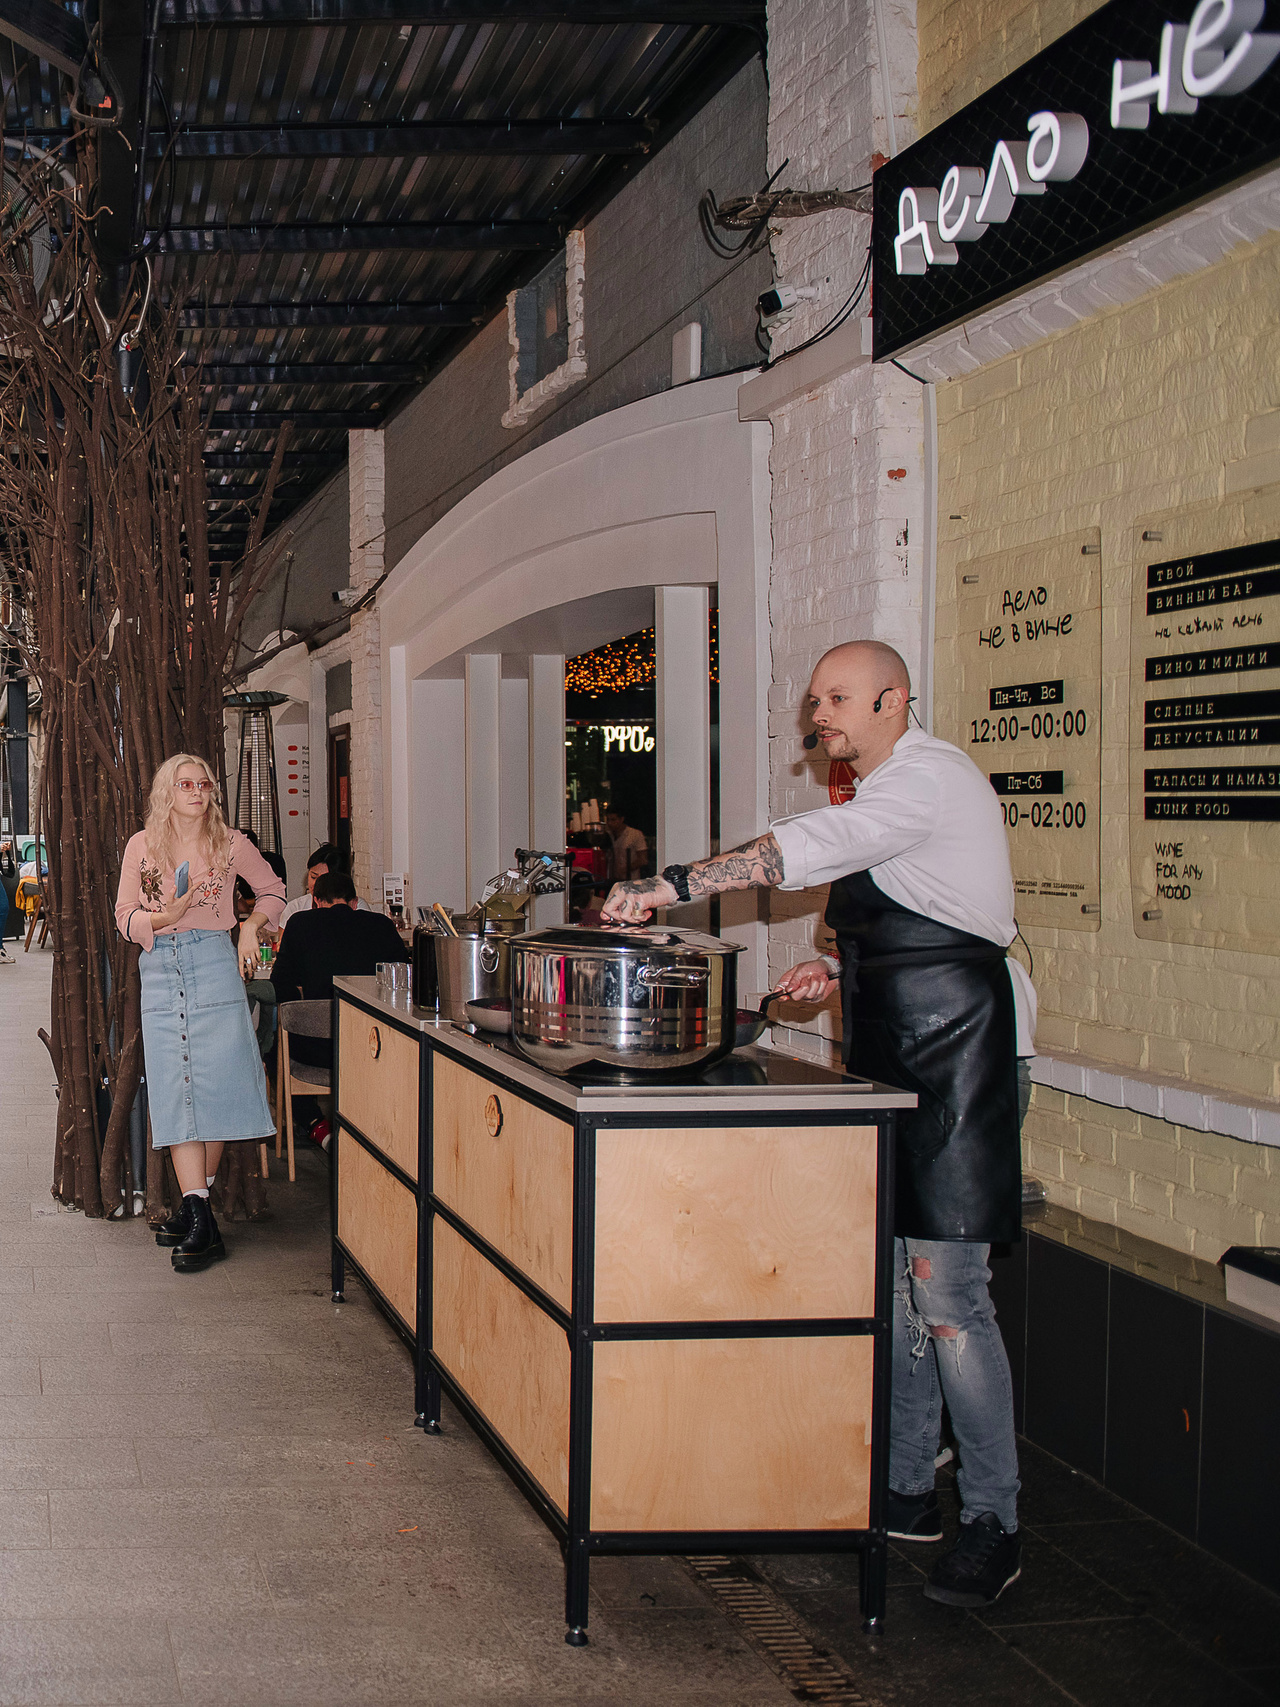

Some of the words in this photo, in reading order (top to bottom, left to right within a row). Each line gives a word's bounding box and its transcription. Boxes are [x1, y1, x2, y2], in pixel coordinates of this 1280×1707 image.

[1157, 561, 1194, 581] ТВОЙ
[1156, 585, 1216, 609] ВИННЫЙ
[1222, 582, 1253, 598] БАР
[979, 626, 1005, 648] не
[1025, 613, 1072, 641] вине
[1155, 627, 1171, 639] на
[1232, 613, 1263, 628] день
[1155, 660, 1193, 675] ВИНО
[1199, 659, 1206, 670] И
[1212, 651, 1268, 669] МИДИИ
[1041, 685, 1056, 700] Вс
[1154, 702, 1214, 718] СЛЕПЫЕ
[971, 709, 1087, 743] 12:00-00:00
[1154, 728, 1259, 746] ДЕГУСТАЦИИ
[1007, 774, 1042, 790] Пт-Сб
[1154, 774, 1206, 787] ТАПАСЫ
[1212, 774, 1220, 786] И
[1154, 803, 1188, 815] JUNK
[1195, 803, 1230, 815] FOOD
[1156, 862, 1178, 878] FOR
[1156, 883, 1191, 900] MOOD
